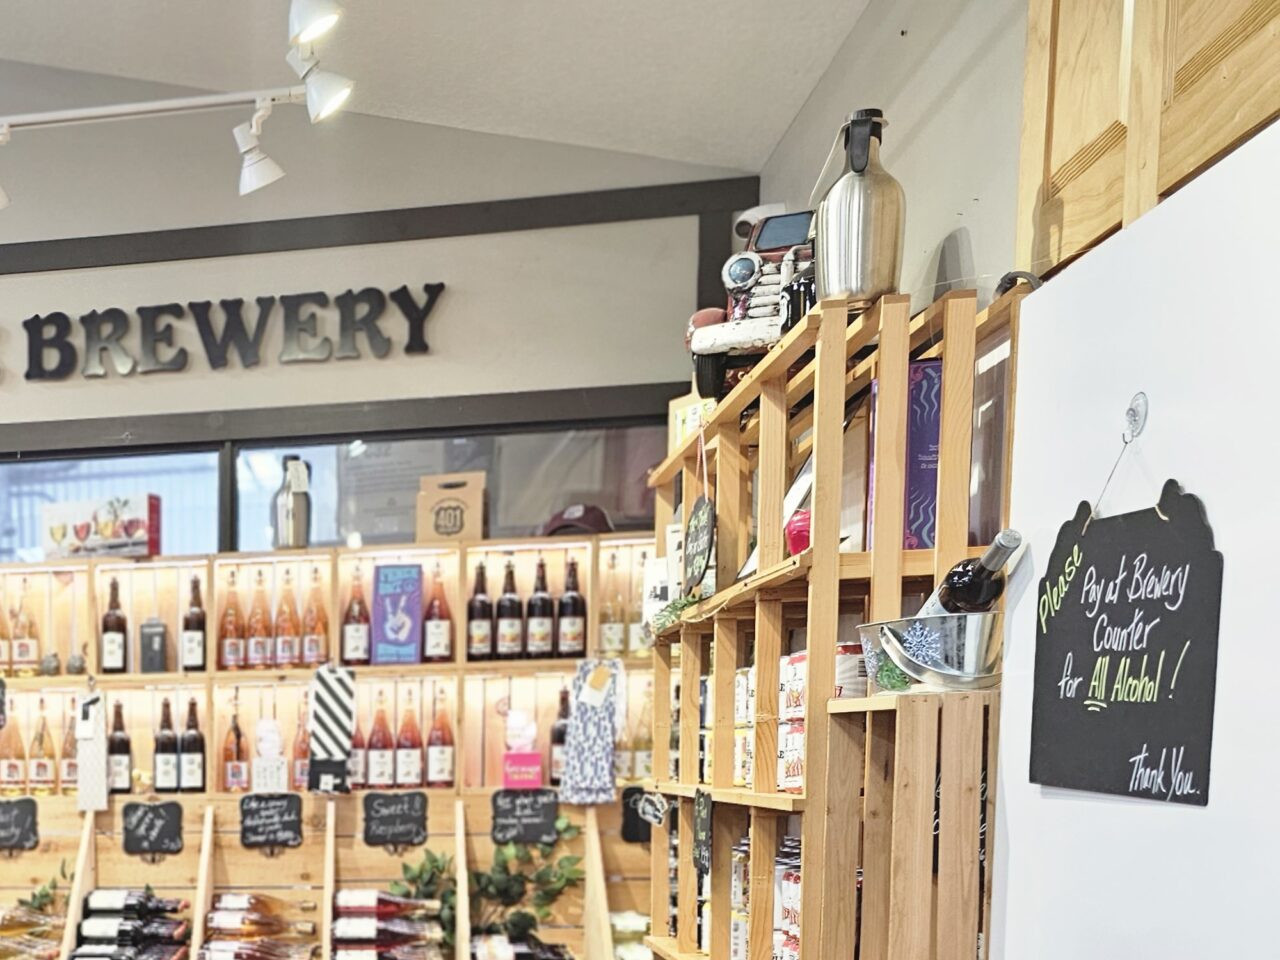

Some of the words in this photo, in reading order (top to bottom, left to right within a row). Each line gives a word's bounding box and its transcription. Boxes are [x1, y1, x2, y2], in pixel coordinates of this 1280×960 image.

[22, 281, 447, 381] BREWERY
[437, 507, 462, 525] 401
[1038, 543, 1083, 634] Please
[1080, 565, 1105, 618] Pay
[1105, 554, 1128, 604] at
[1126, 553, 1190, 611] Brewery
[1093, 608, 1161, 652] Counter
[1057, 651, 1084, 699] for
[1088, 655, 1110, 700] All
[1110, 649, 1166, 703] Alcohol
[1128, 743, 1167, 793] Thank
